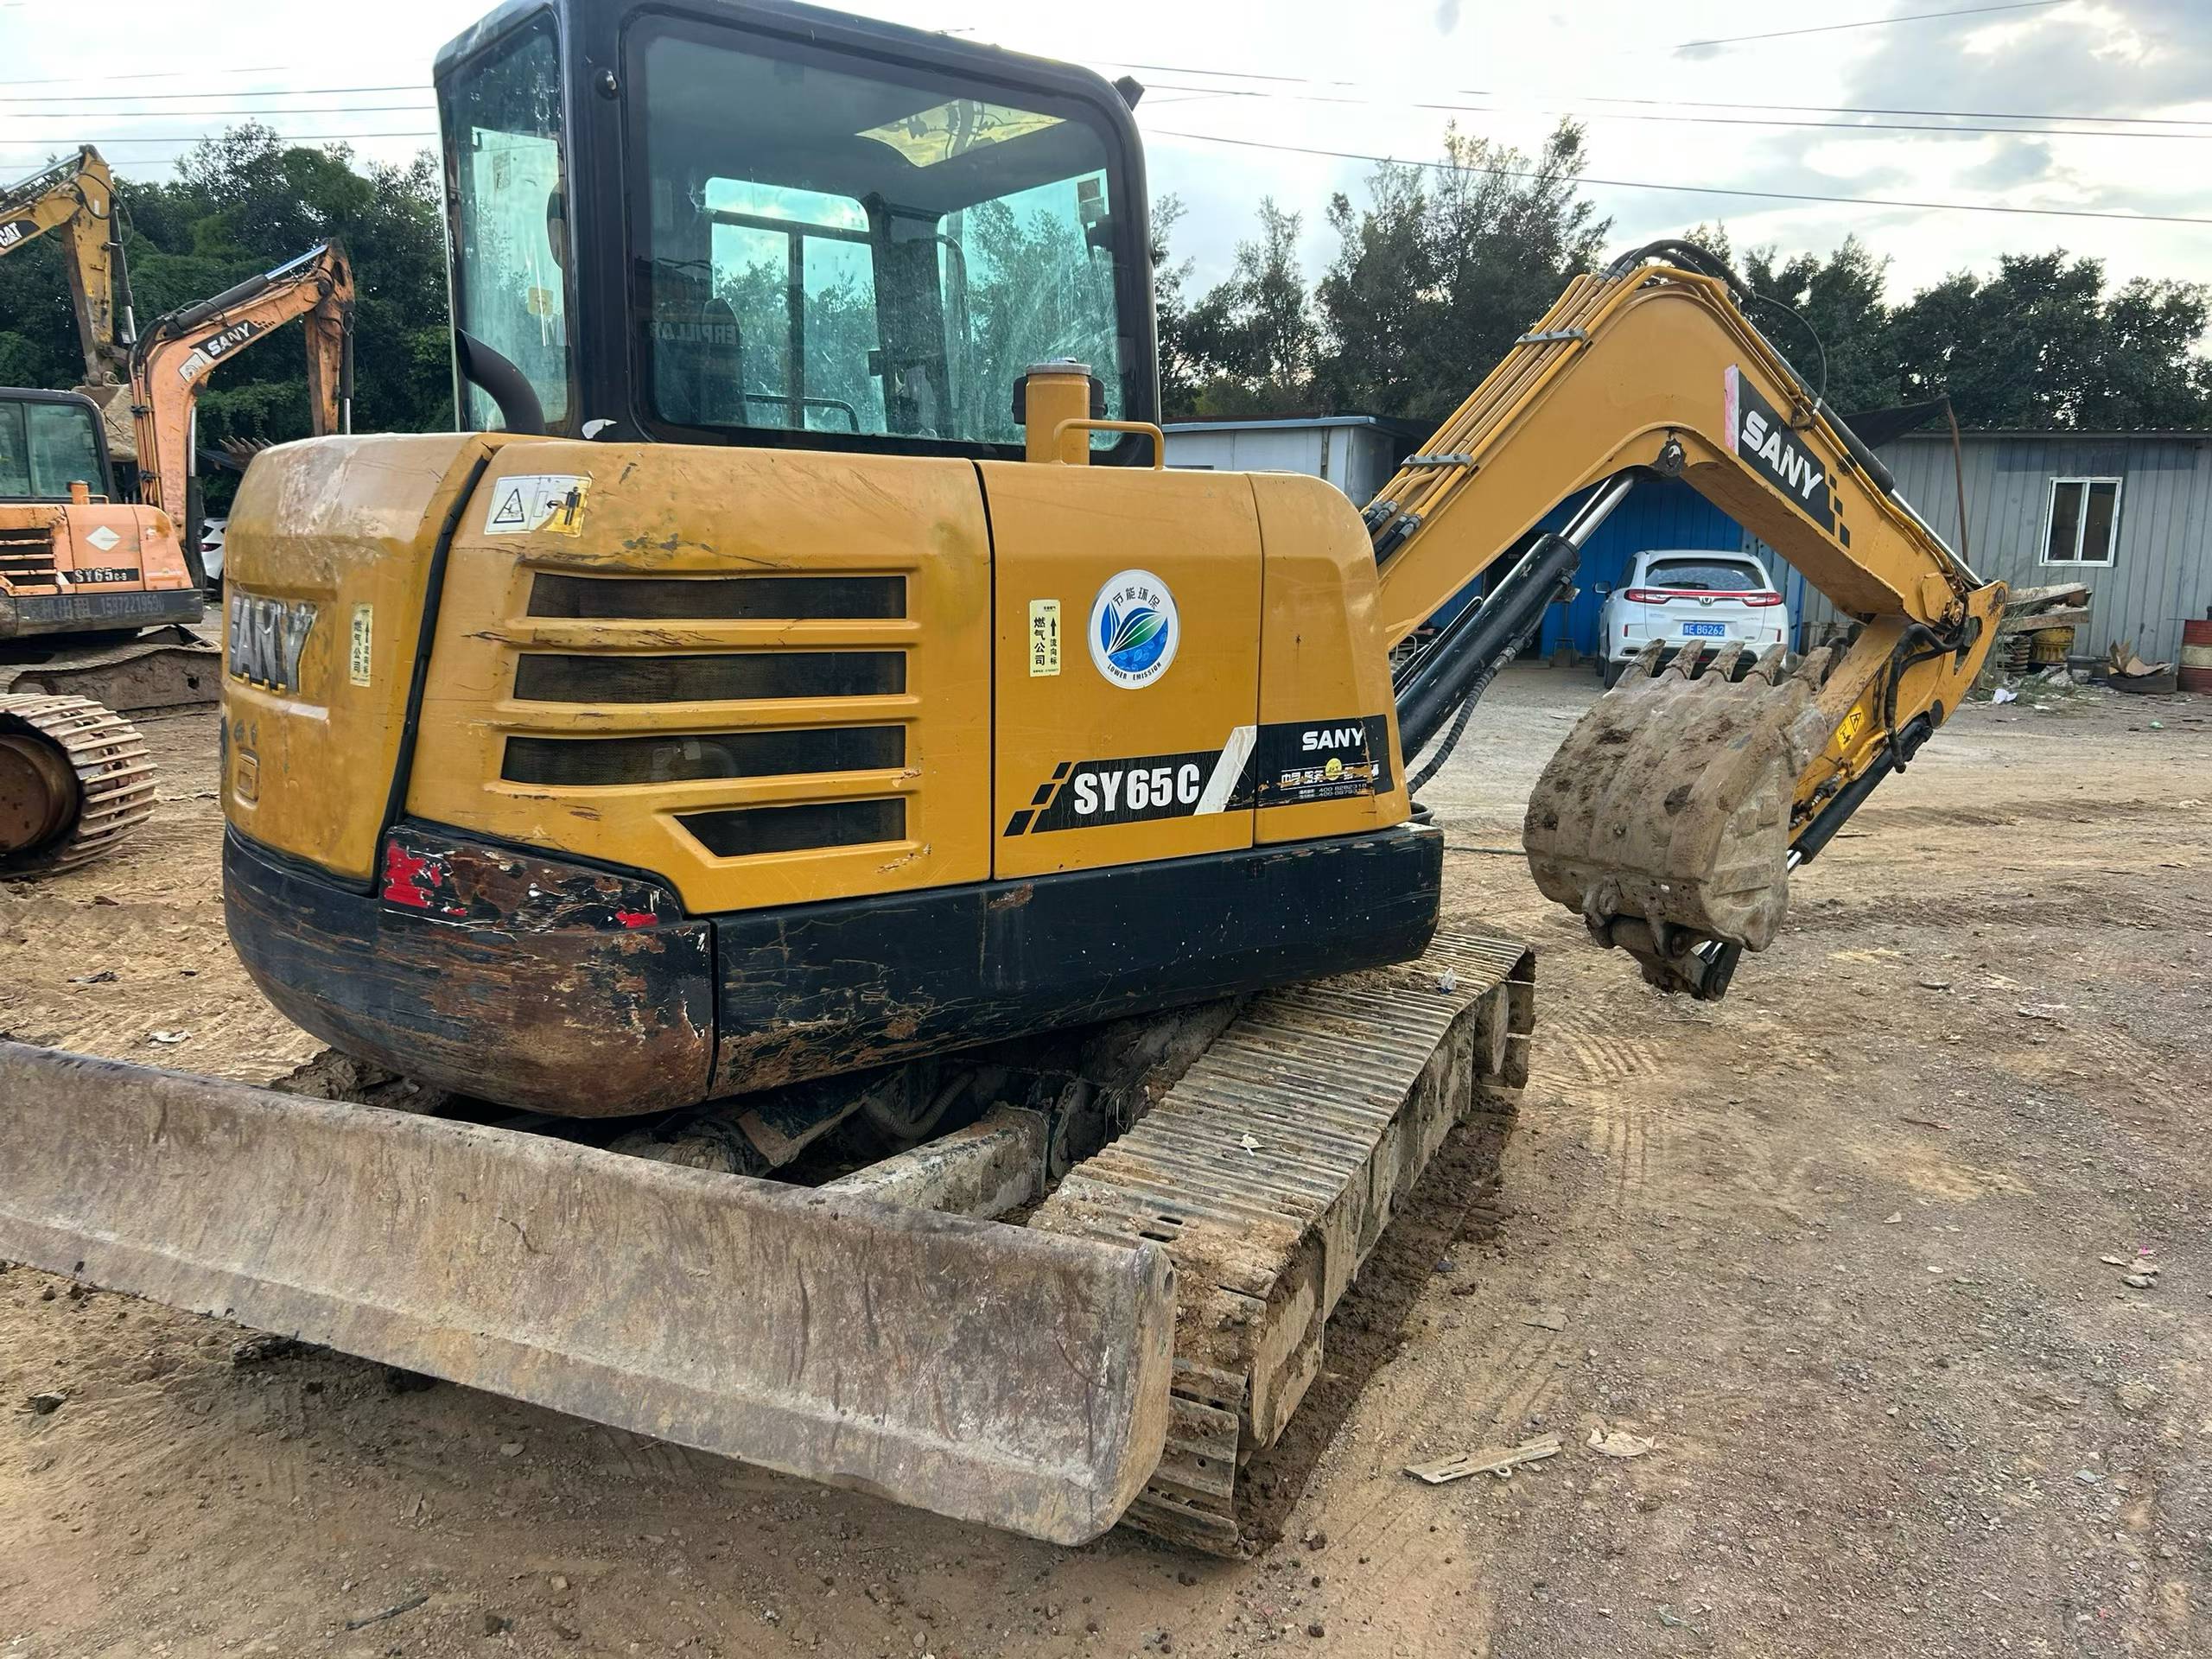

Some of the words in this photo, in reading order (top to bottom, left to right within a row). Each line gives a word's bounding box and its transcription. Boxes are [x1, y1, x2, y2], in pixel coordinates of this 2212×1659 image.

[207, 322, 250, 356] SANY
[1741, 410, 1824, 500] SANY
[1113, 587, 1160, 609] 节能环保
[1033, 616, 1046, 665] 燃气公司
[1107, 663, 1128, 679] LOWER
[1132, 661, 1162, 681] EMISSION
[1302, 728, 1364, 751] SANY
[1074, 763, 1199, 815] SY65C
